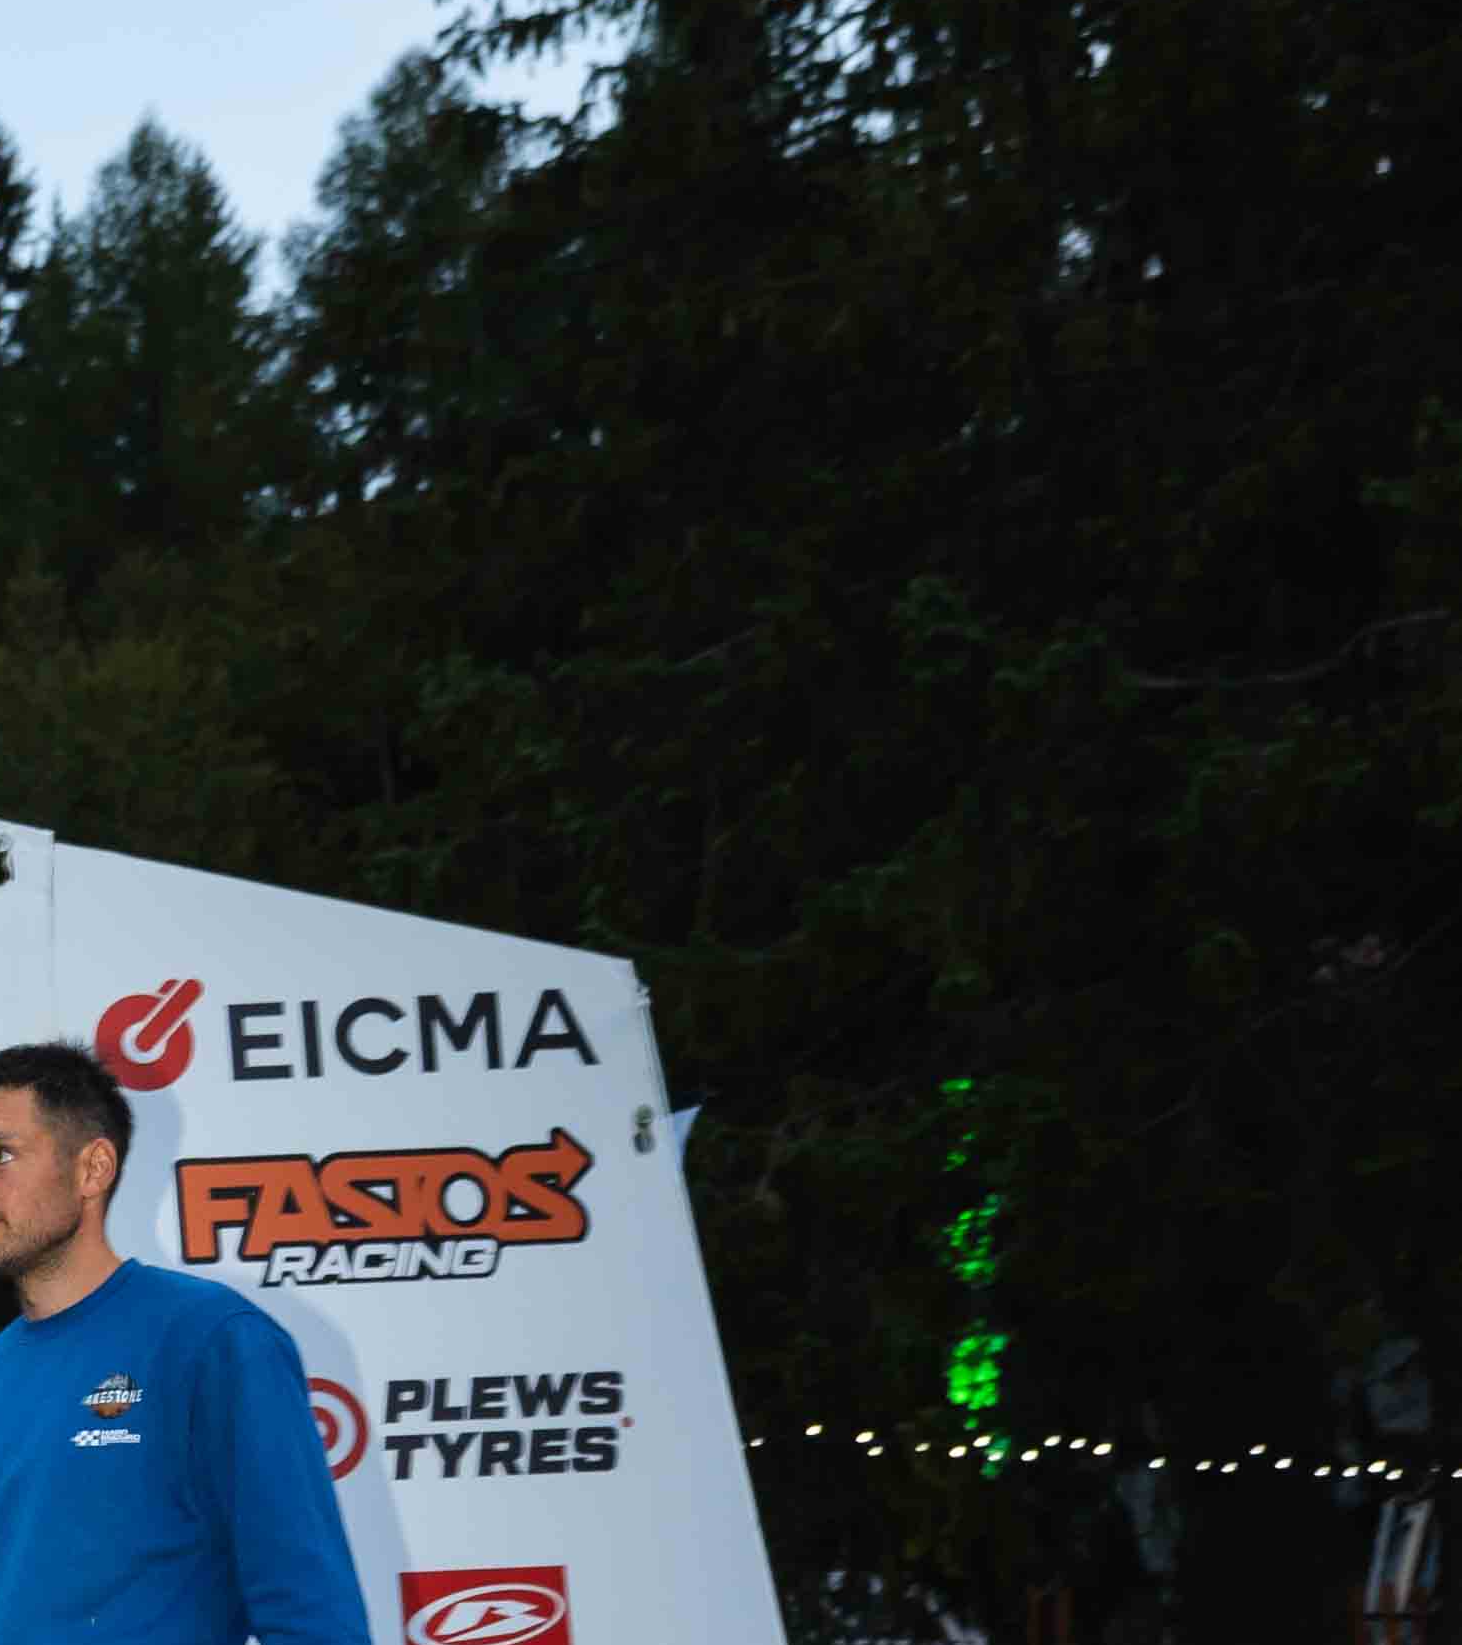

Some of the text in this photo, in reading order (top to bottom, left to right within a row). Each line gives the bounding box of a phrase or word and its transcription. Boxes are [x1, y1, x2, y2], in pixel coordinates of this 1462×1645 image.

[227, 988, 600, 1082] EICMA
[261, 1238, 500, 1287] RACING
[385, 1372, 623, 1423] PLEWS
[385, 1427, 619, 1481] TYRES
